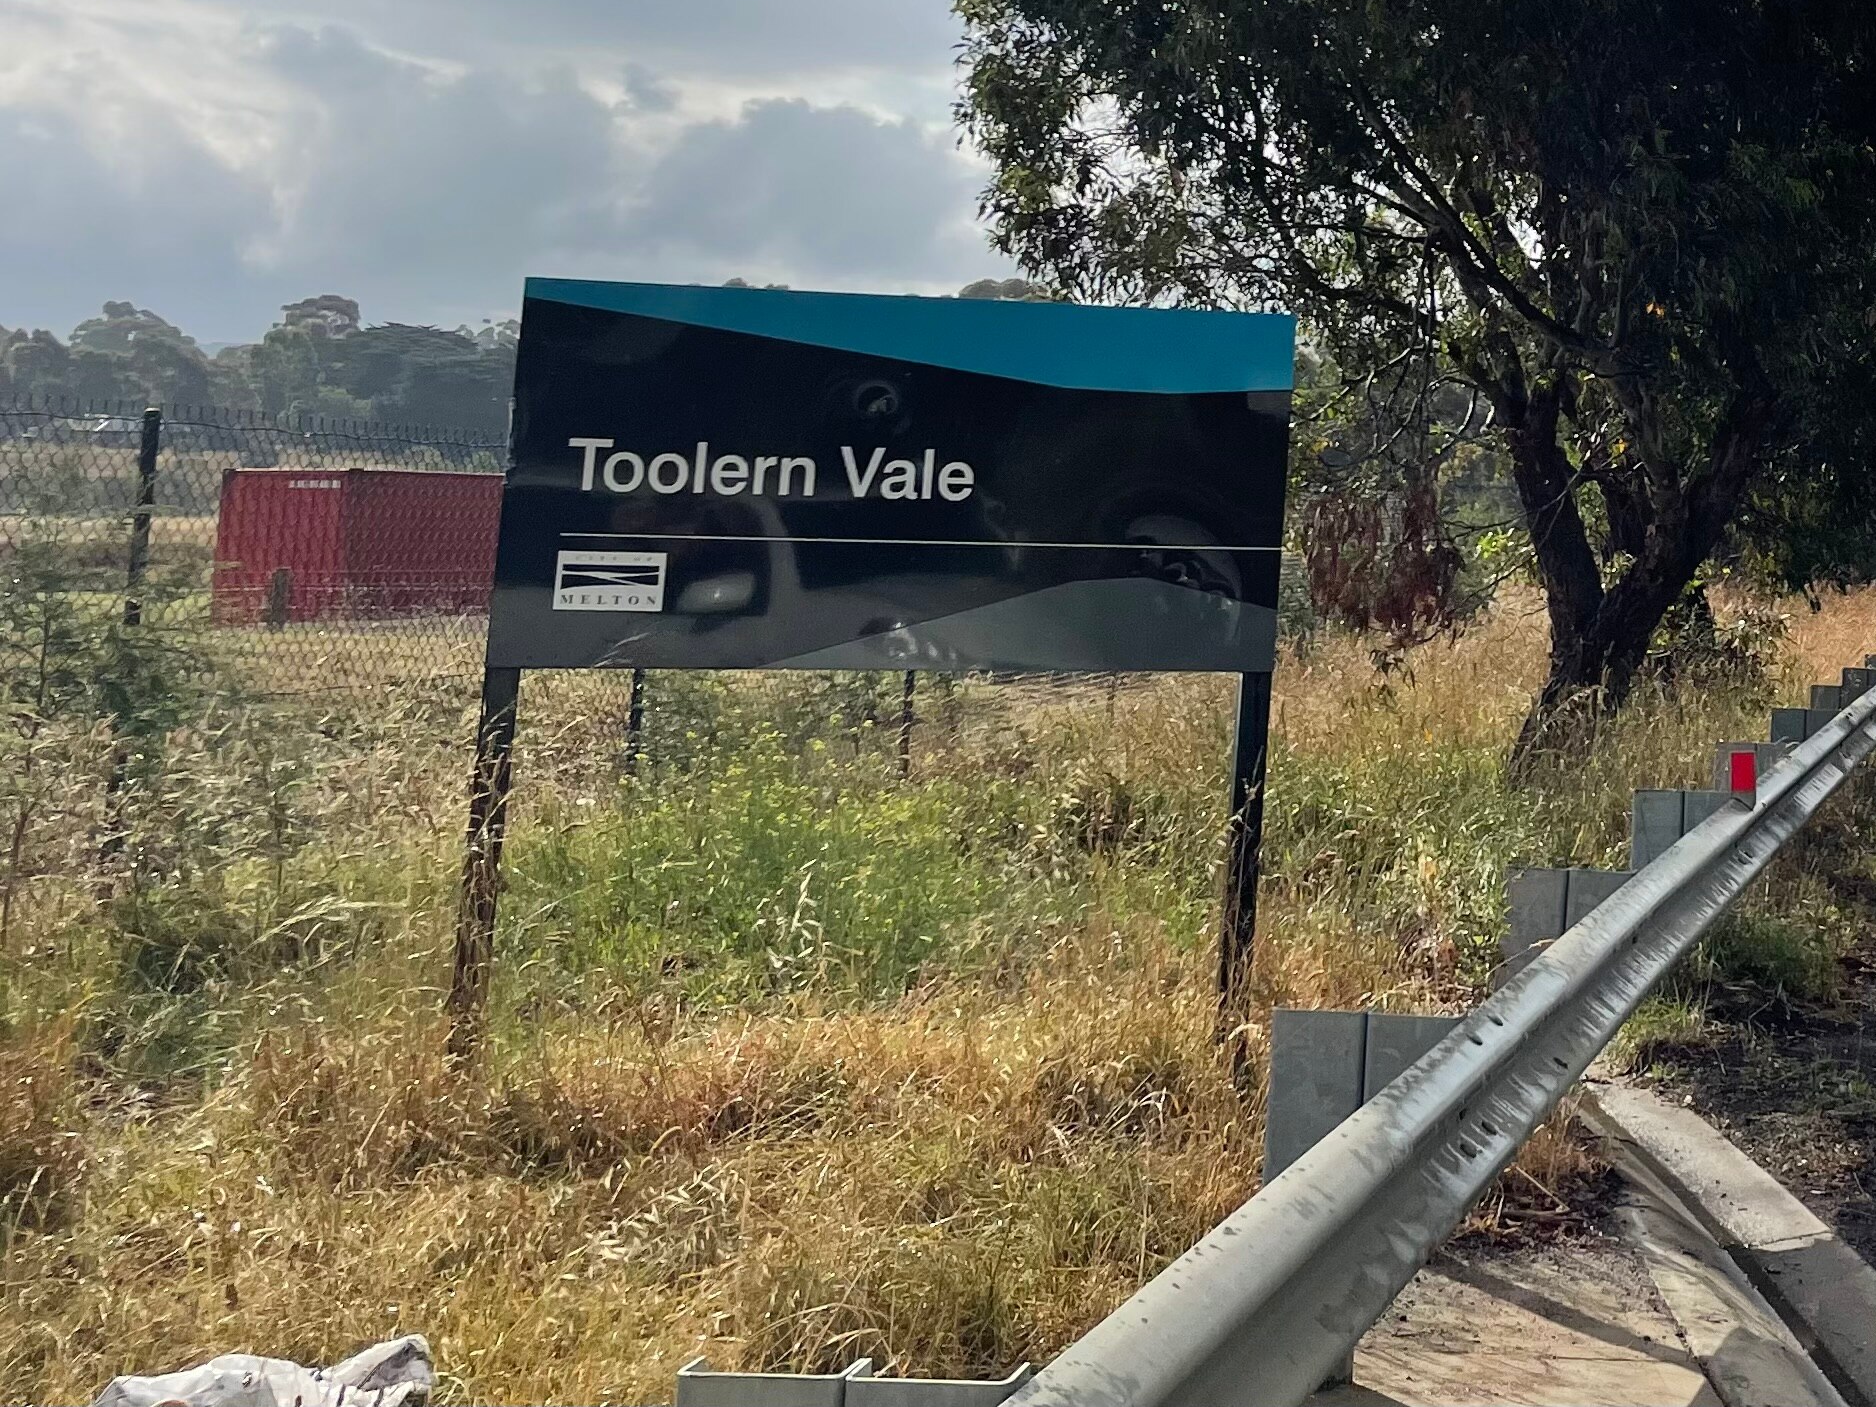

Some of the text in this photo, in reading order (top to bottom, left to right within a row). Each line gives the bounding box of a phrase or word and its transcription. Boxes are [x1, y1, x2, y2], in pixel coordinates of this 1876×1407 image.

[568, 437, 974, 502] Toolern Vale
[560, 594, 656, 606] MELTON
